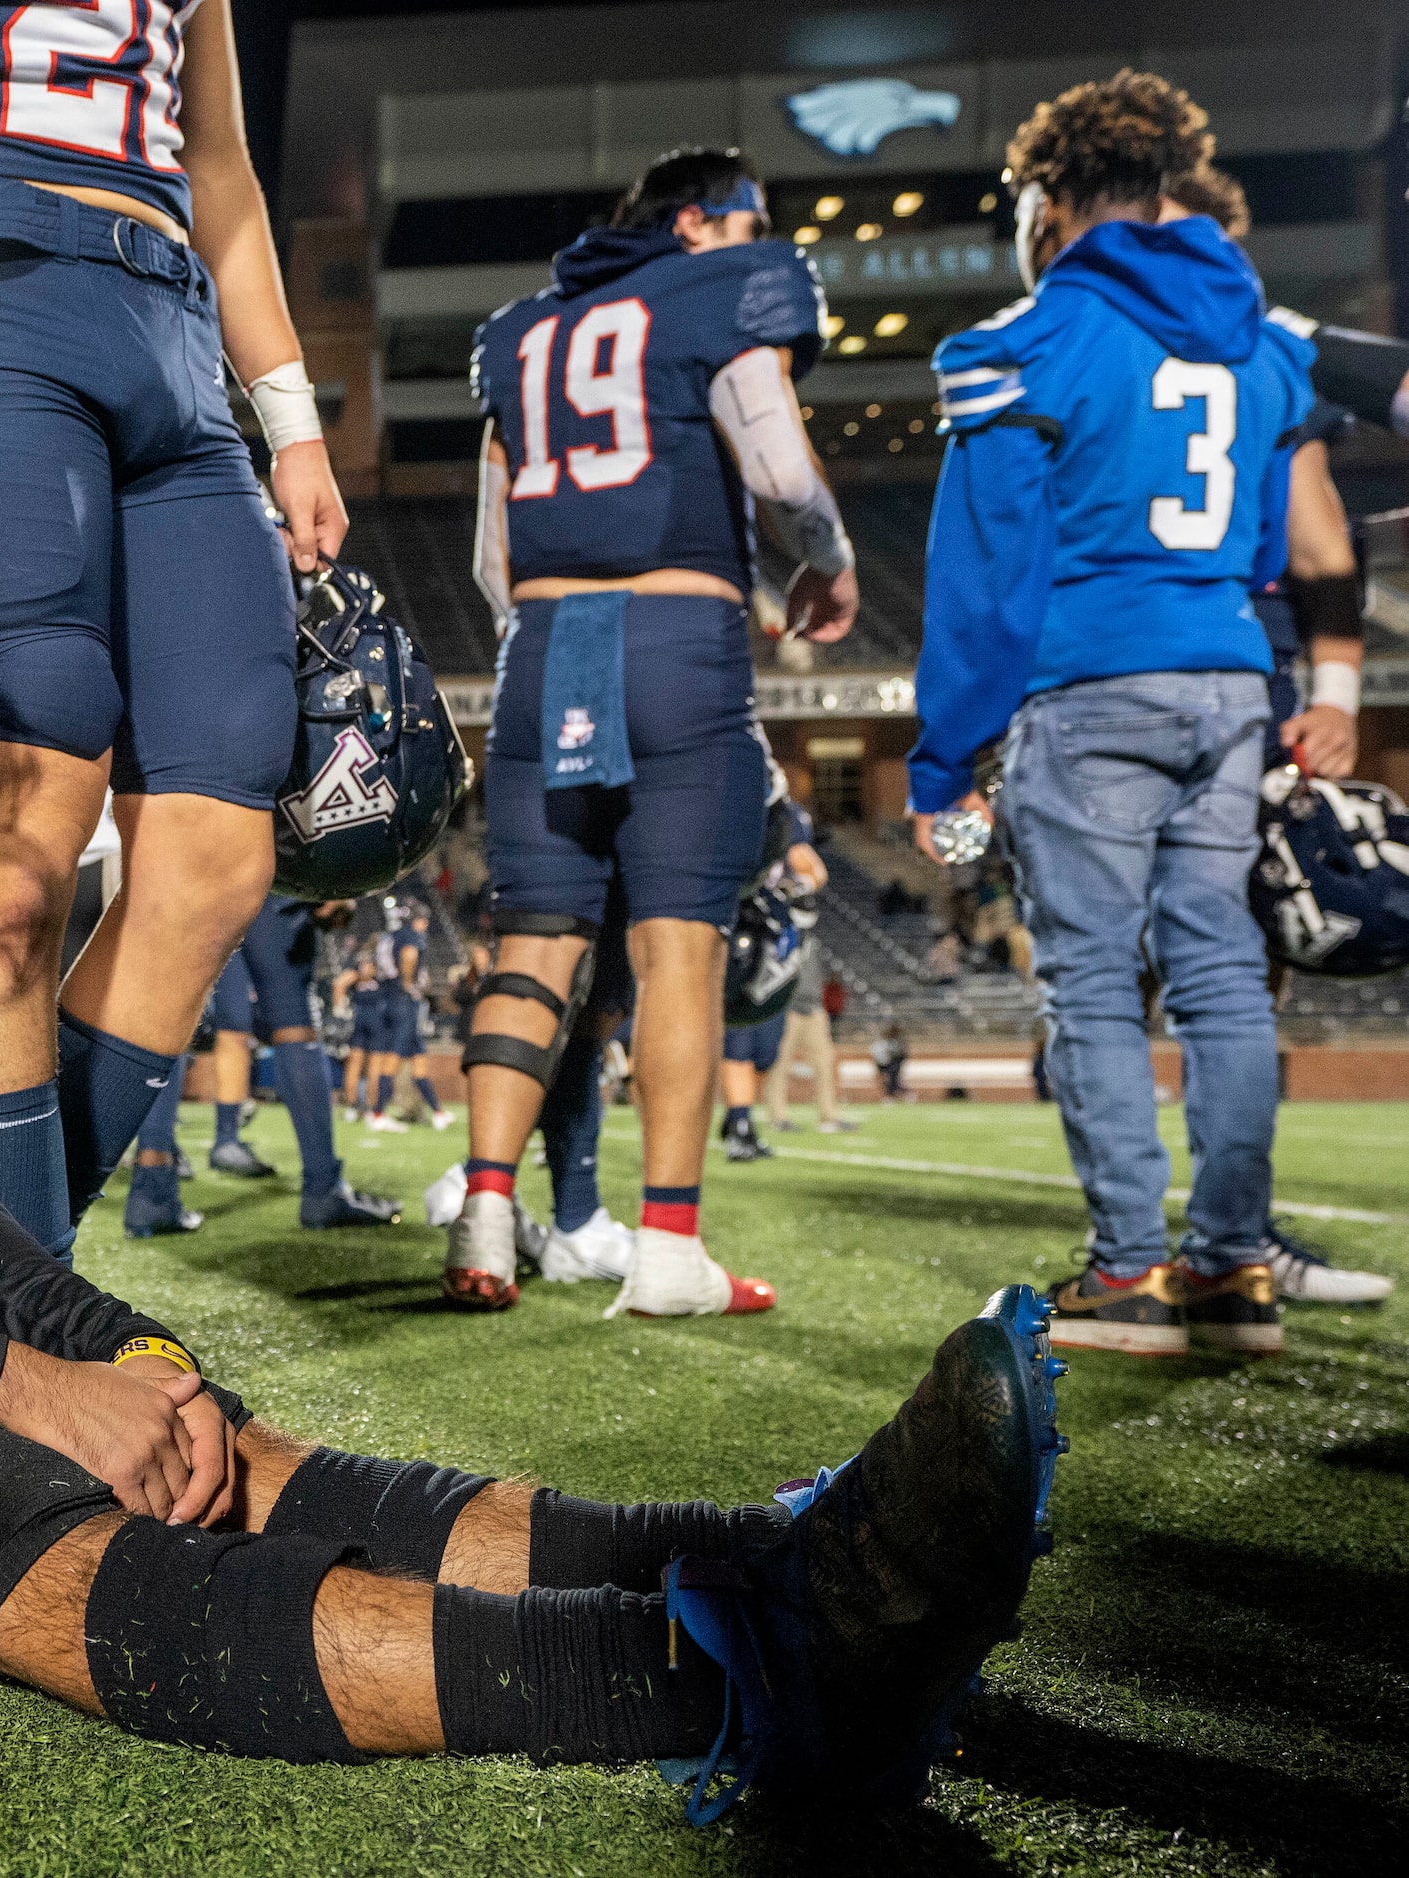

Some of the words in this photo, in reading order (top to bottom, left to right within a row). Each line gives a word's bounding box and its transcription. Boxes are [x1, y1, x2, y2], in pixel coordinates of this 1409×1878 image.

[863, 246, 993, 281] ALLEN
[510, 297, 653, 500] 19
[1149, 356, 1237, 550] 3
[278, 724, 399, 844] A
